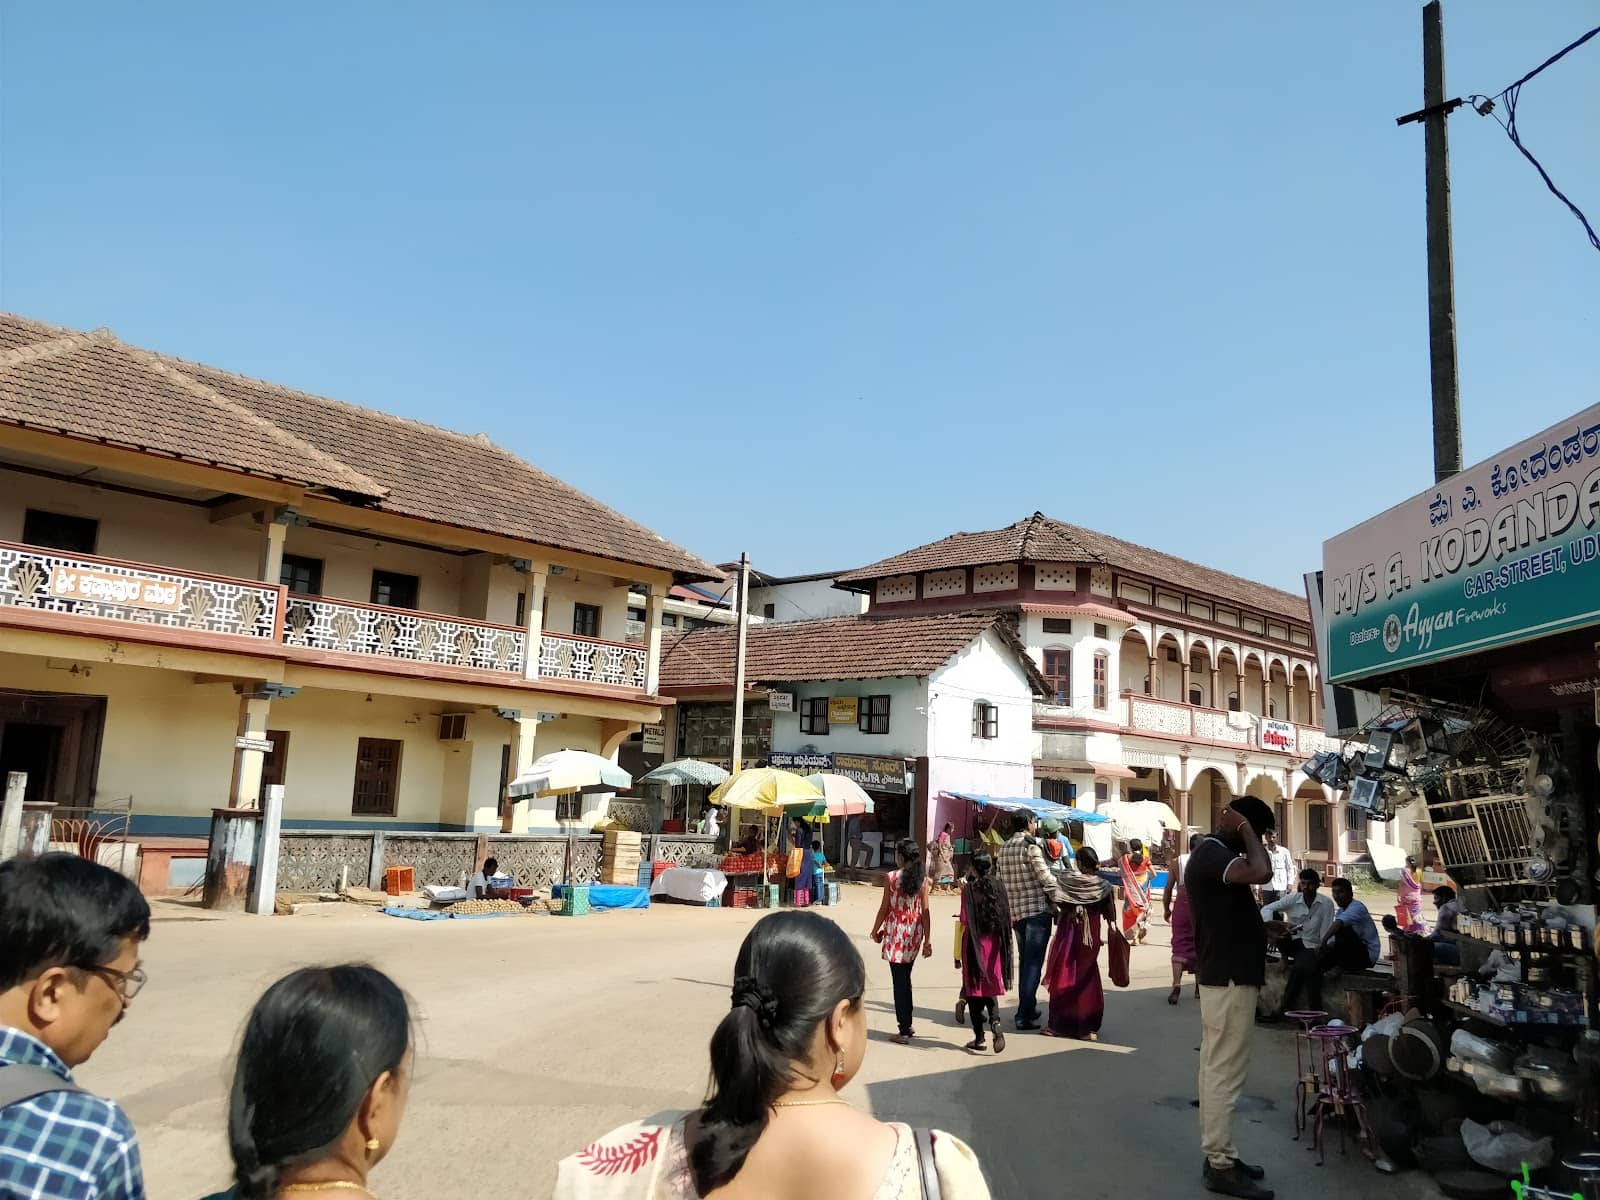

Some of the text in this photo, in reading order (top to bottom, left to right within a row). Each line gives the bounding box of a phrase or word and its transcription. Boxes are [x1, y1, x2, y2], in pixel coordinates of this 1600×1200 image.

[1491, 424, 1600, 499] ಕೋದಂಡರ
[55, 569, 77, 594] ಶ್ರೀ
[143, 583, 177, 604] ಮಠ
[1334, 563, 1376, 617] M/S
[1384, 551, 1411, 600] A.
[1464, 533, 1600, 598] CAR-STREET, UD
[1403, 602, 1454, 650] Ayyan
